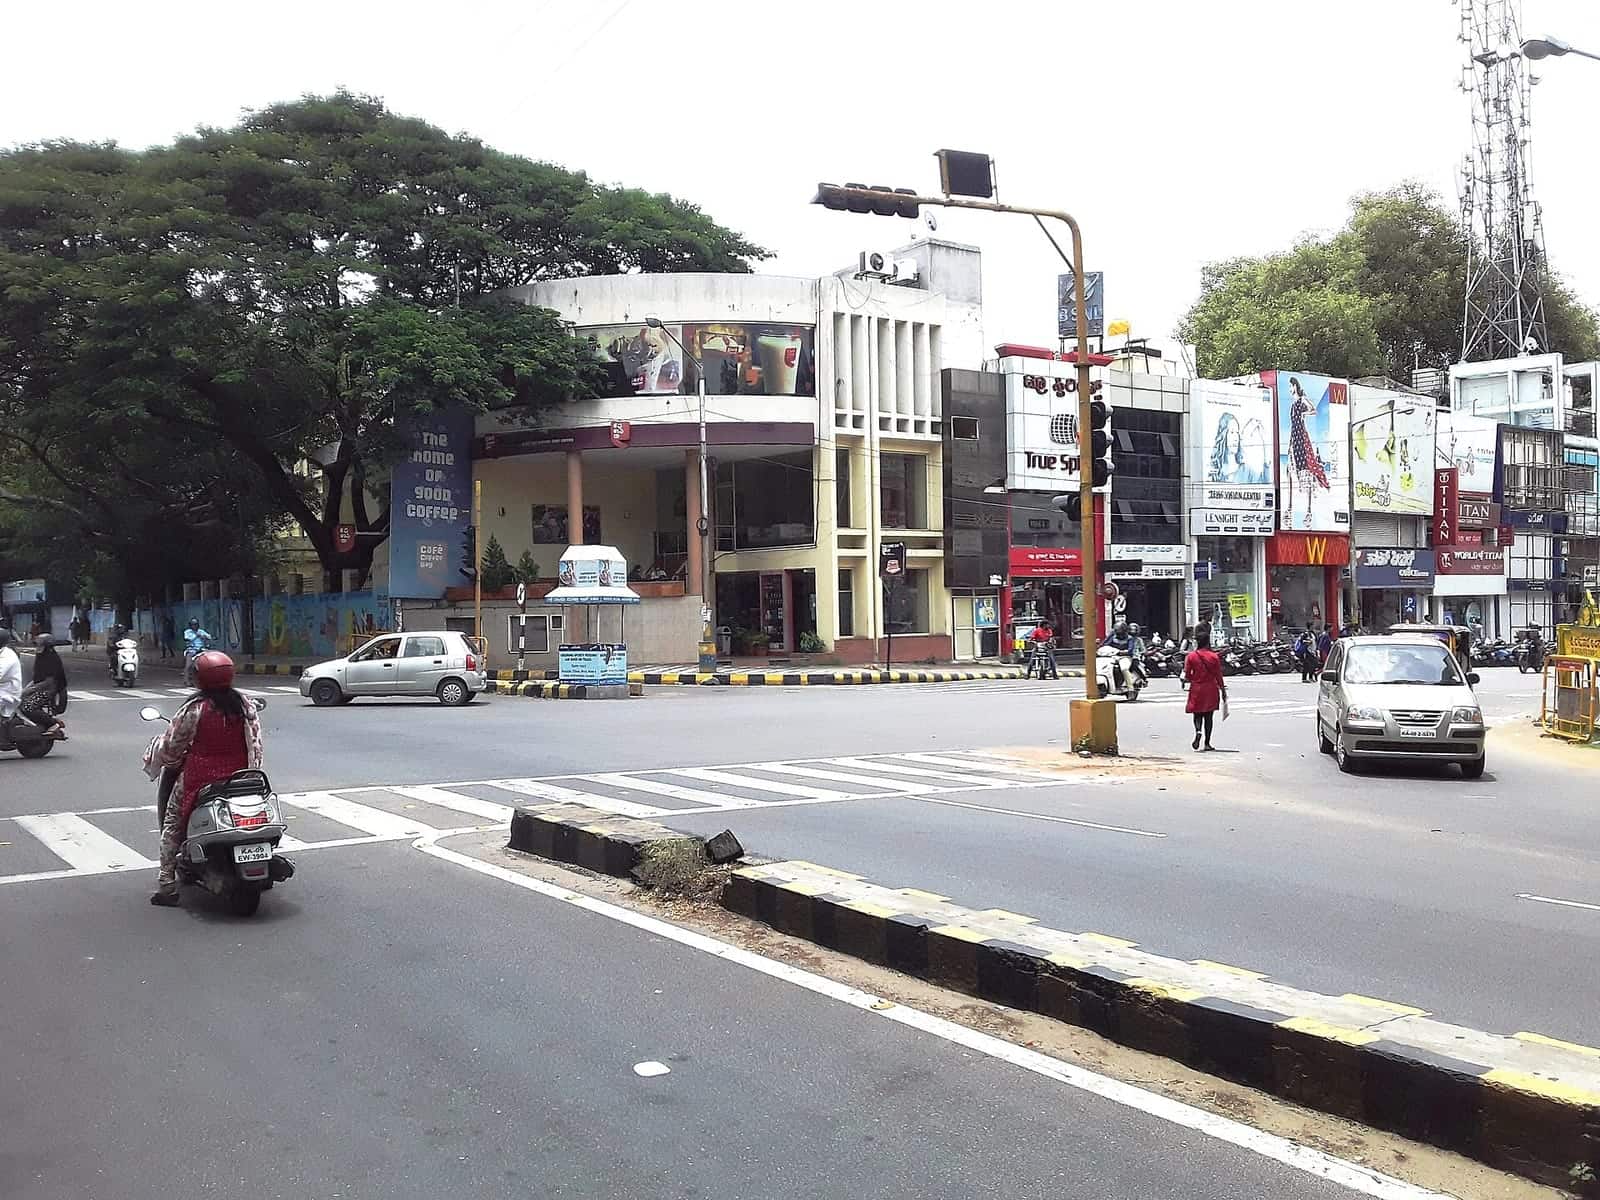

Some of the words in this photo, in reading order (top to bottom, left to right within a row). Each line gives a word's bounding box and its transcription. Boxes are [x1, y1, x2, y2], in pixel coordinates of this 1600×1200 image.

[1024, 451, 1057, 470] True
[1439, 485, 1449, 541] TITAN
[1460, 503, 1489, 517] ITAN
[1305, 537, 1327, 565] W
